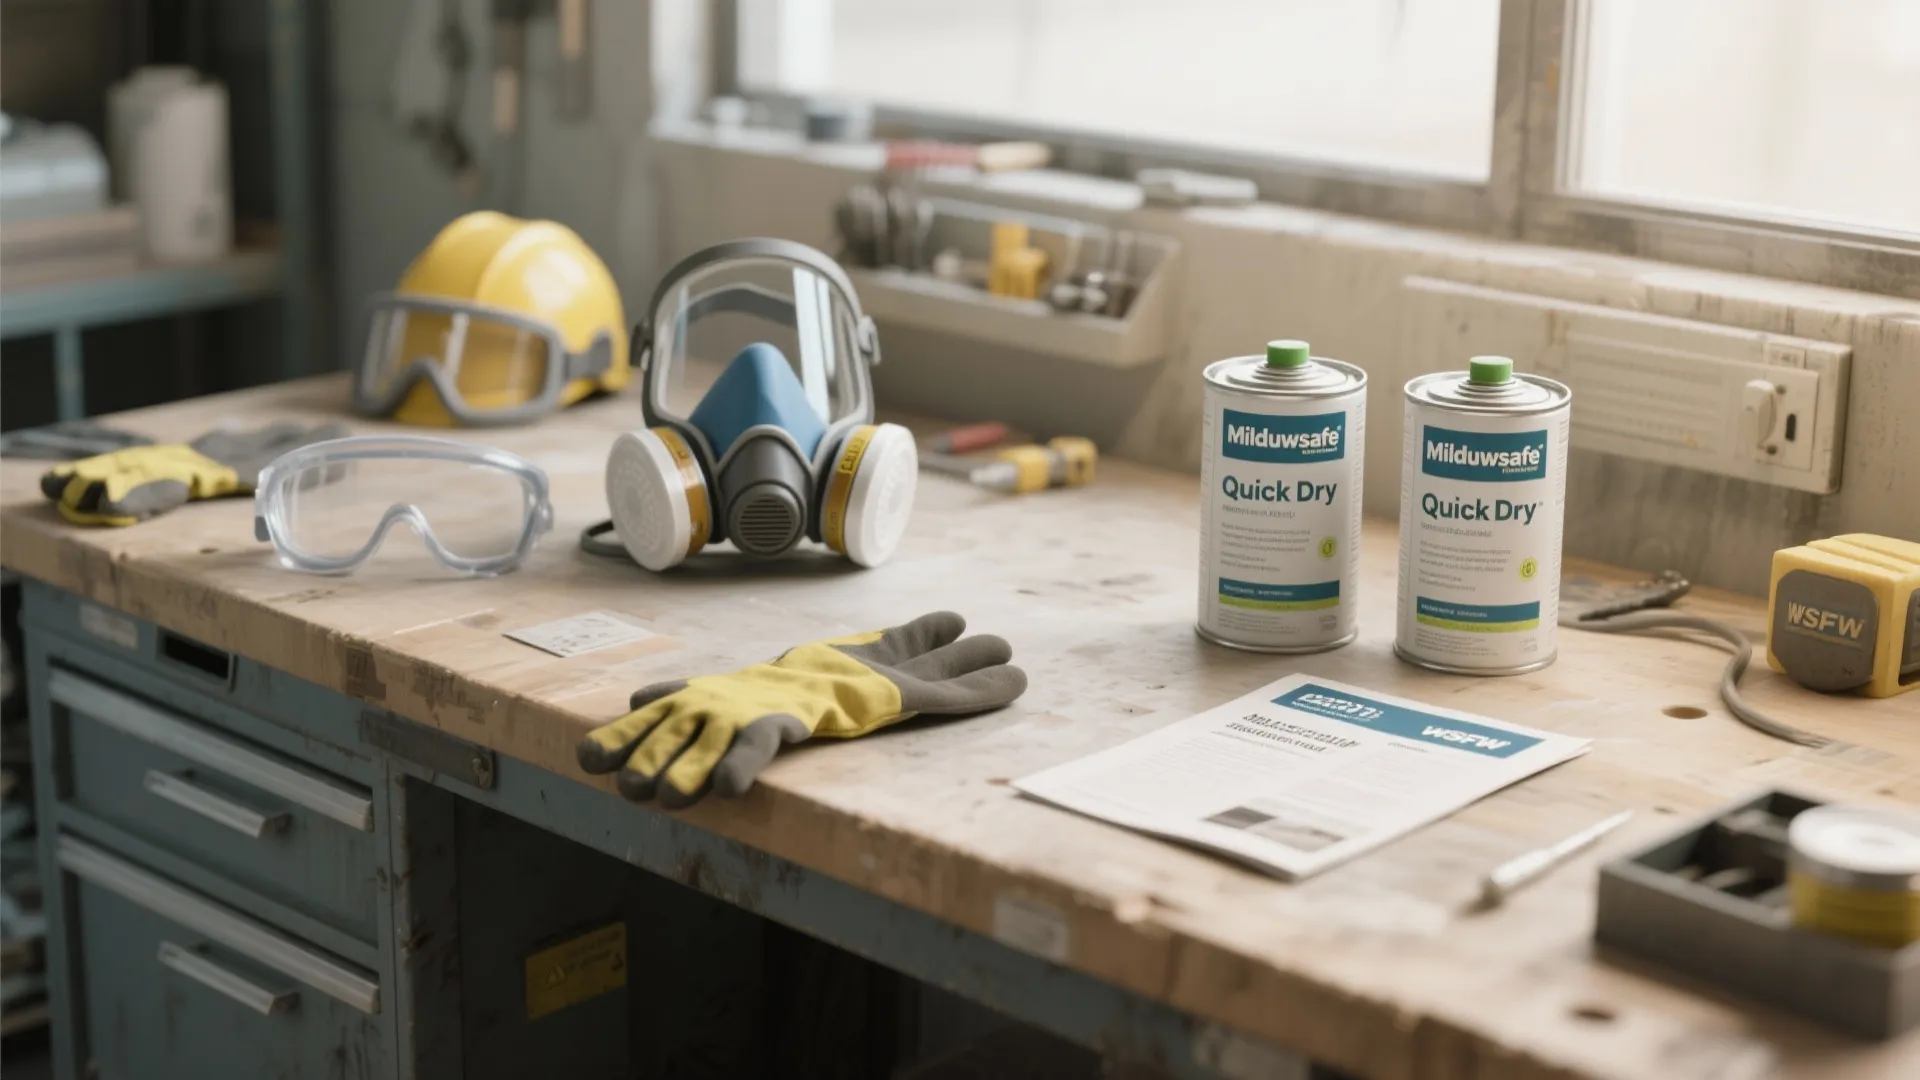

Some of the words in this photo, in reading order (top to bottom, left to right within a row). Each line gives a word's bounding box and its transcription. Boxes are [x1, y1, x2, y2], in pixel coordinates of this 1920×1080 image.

[1227, 423, 1340, 448] Milduwsafe
[1426, 440, 1541, 467] Milduwsafe
[1222, 475, 1291, 502] Quick
[1297, 480, 1338, 506] Dry
[1421, 492, 1490, 521] Quick
[1495, 499, 1537, 526] Dry
[1788, 601, 1864, 639] WSFW
[1421, 725, 1511, 750] WSFW
